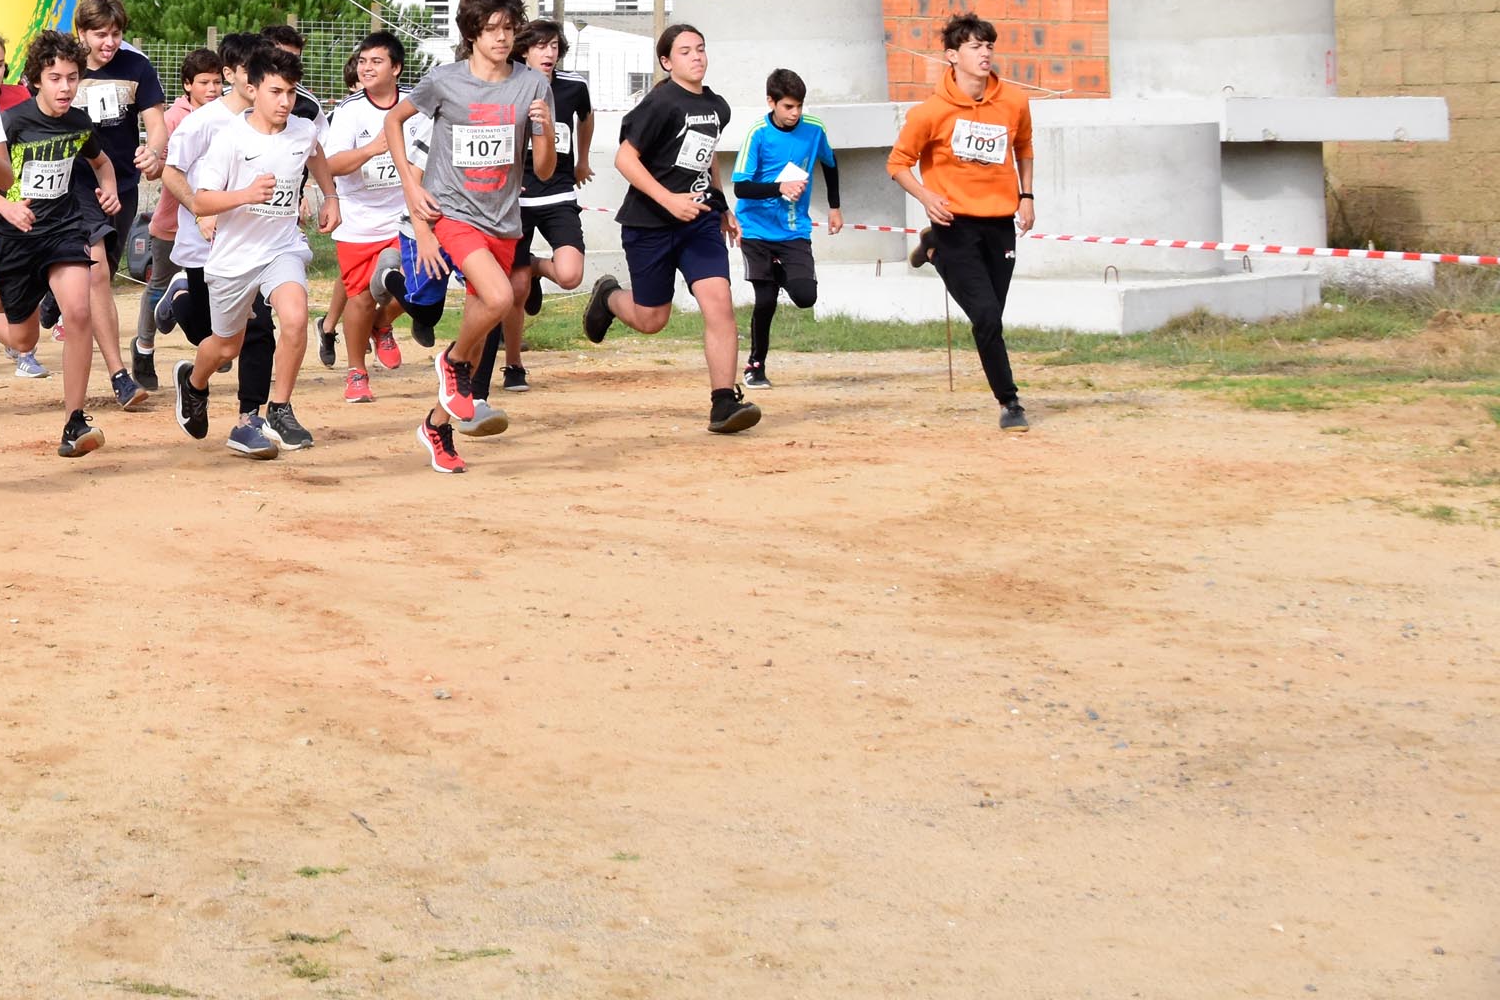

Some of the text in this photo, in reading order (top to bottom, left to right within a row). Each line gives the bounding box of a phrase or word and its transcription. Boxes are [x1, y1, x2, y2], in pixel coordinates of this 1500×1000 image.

[466, 140, 502, 157] 107
[965, 135, 996, 153] 109
[377, 165, 397, 180] 72
[33, 173, 65, 190] 217
[264, 190, 294, 207] 22
[249, 207, 275, 215] SANTIAGO
